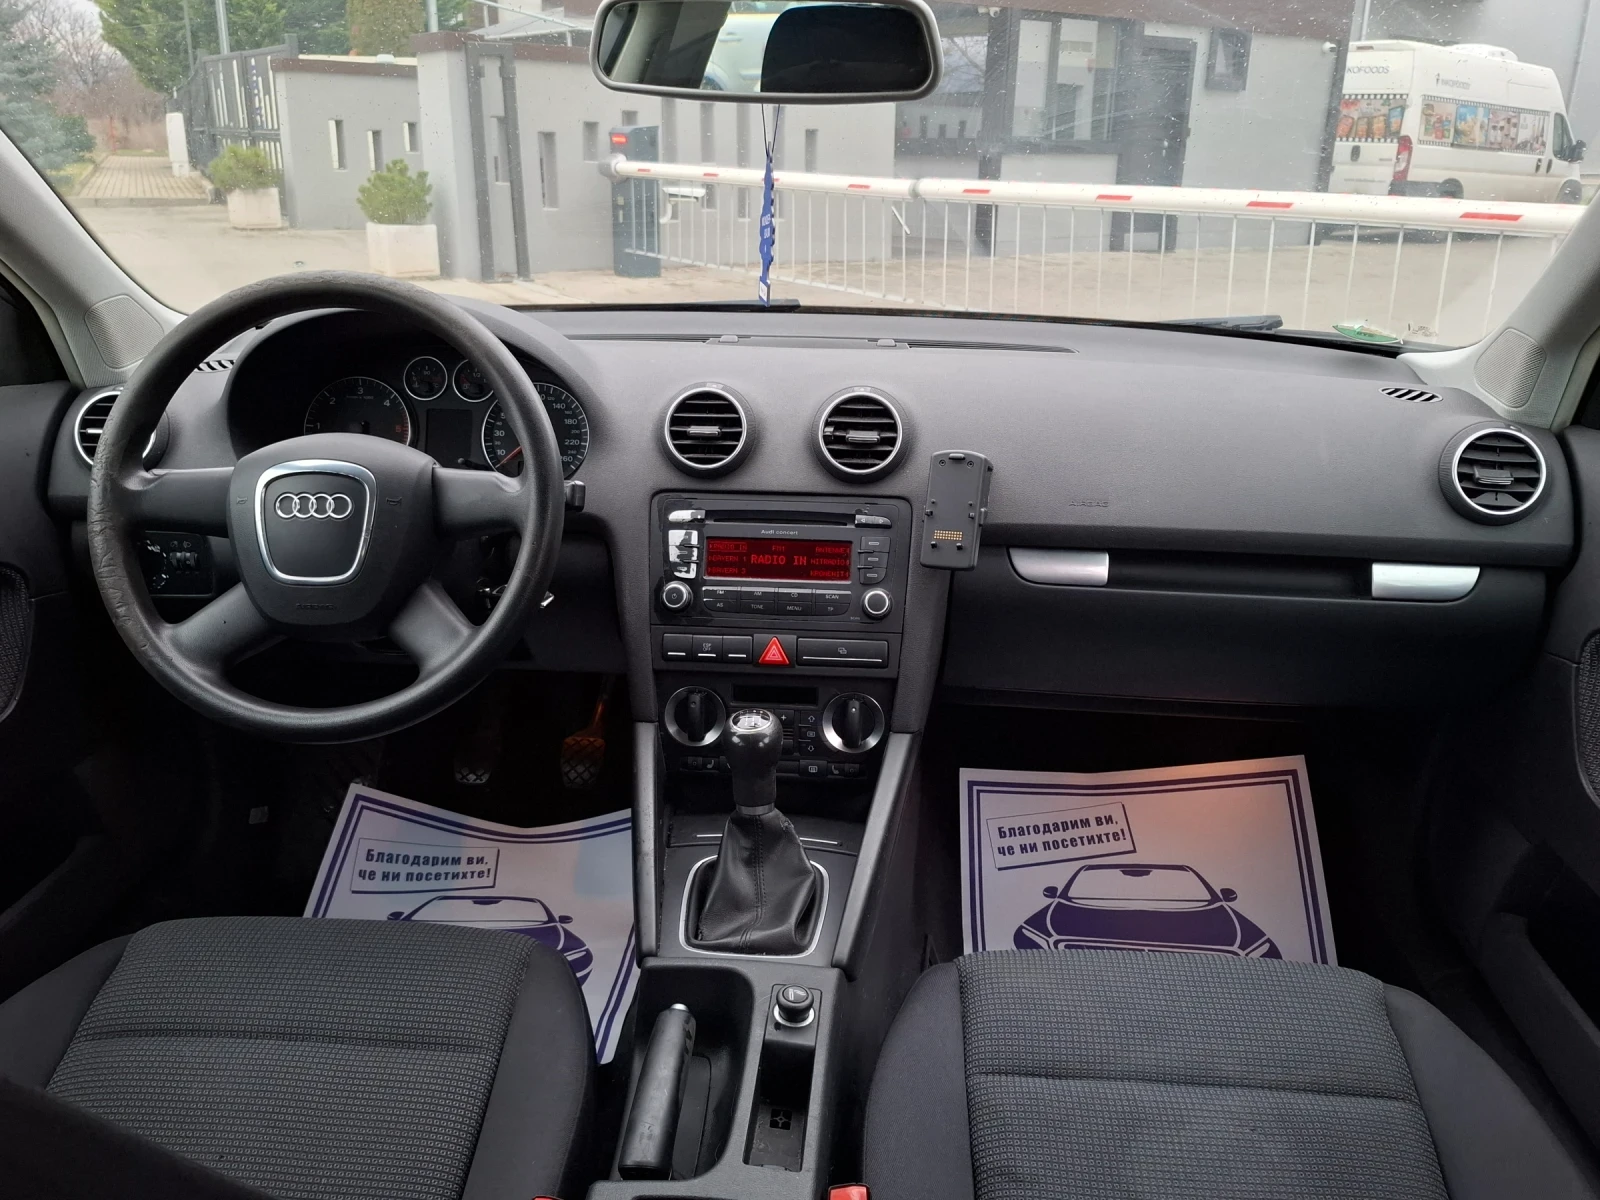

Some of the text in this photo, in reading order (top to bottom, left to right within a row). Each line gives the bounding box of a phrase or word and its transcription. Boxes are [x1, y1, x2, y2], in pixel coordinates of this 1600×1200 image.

[357, 386, 364, 394] 3
[383, 399, 391, 407] 4
[751, 554, 807, 566] RADIO IN
[997, 817, 1091, 839] Благодарим
[997, 828, 1127, 857] че ни посетихте!
[365, 848, 462, 867] Благодарим
[358, 867, 491, 883] че ни посетихте!
